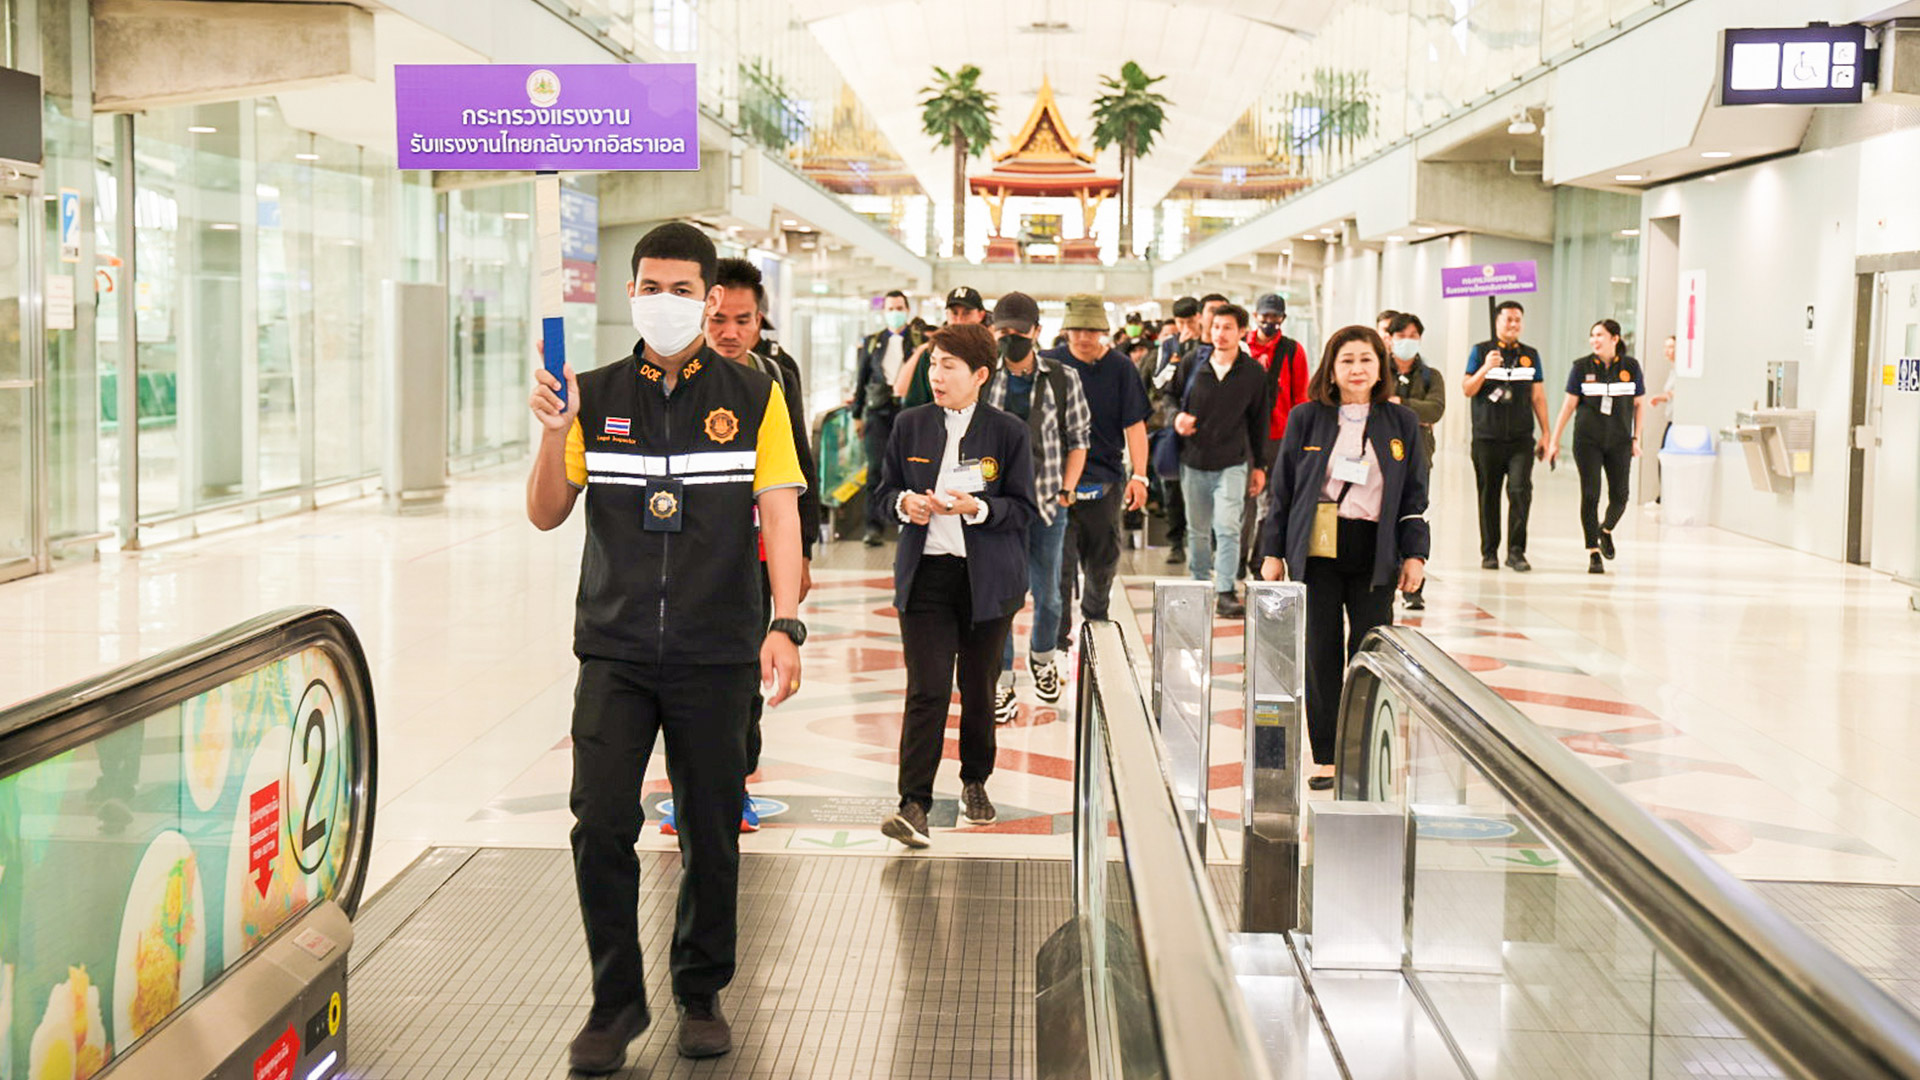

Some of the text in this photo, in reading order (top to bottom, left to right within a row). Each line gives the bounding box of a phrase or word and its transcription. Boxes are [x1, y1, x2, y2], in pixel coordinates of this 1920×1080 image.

[462, 107, 630, 126] กระทรวงแรงงาน
[410, 130, 685, 153] รับแรงงานไทยกลับจากอิสราเอล
[640, 364, 662, 382] DOE
[682, 358, 703, 380] DOE
[302, 709, 326, 851] 2
